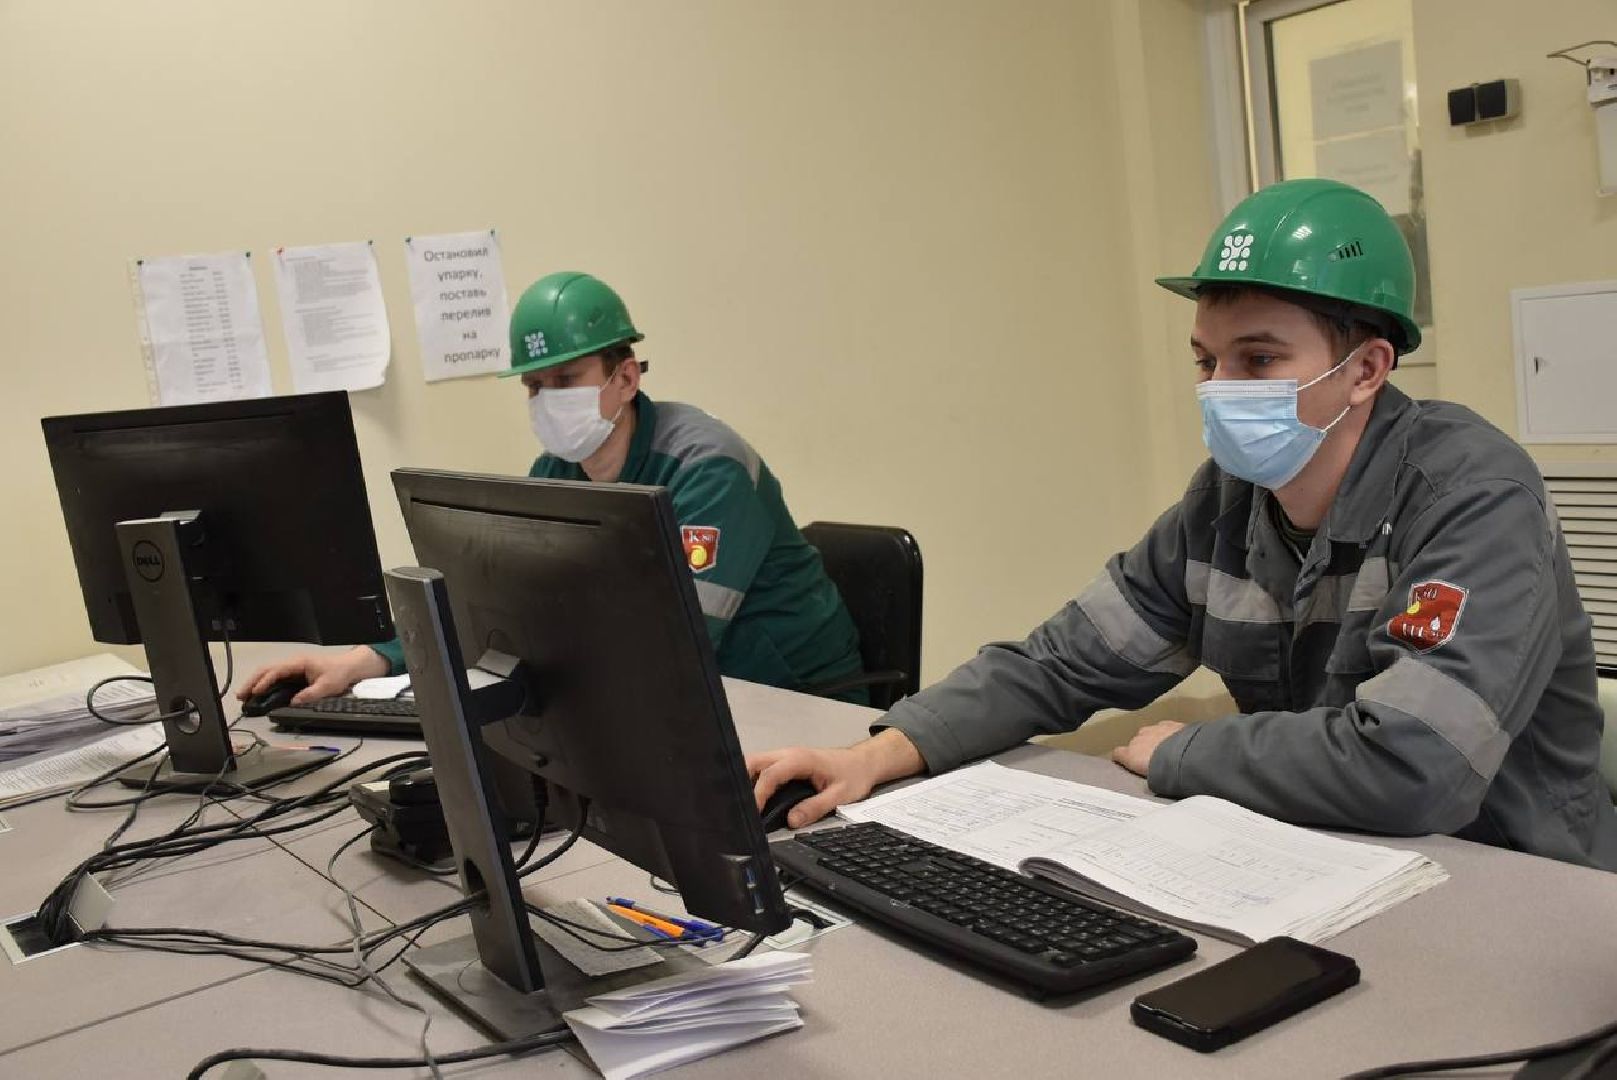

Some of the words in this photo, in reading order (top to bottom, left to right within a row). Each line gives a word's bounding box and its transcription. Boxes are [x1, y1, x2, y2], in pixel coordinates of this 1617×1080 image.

[424, 247, 488, 262] Остановил
[440, 289, 487, 301] поставь
[441, 308, 491, 321] перелив
[463, 331, 477, 340] на
[444, 348, 501, 363] пропарку
[136, 555, 161, 566] DELL
